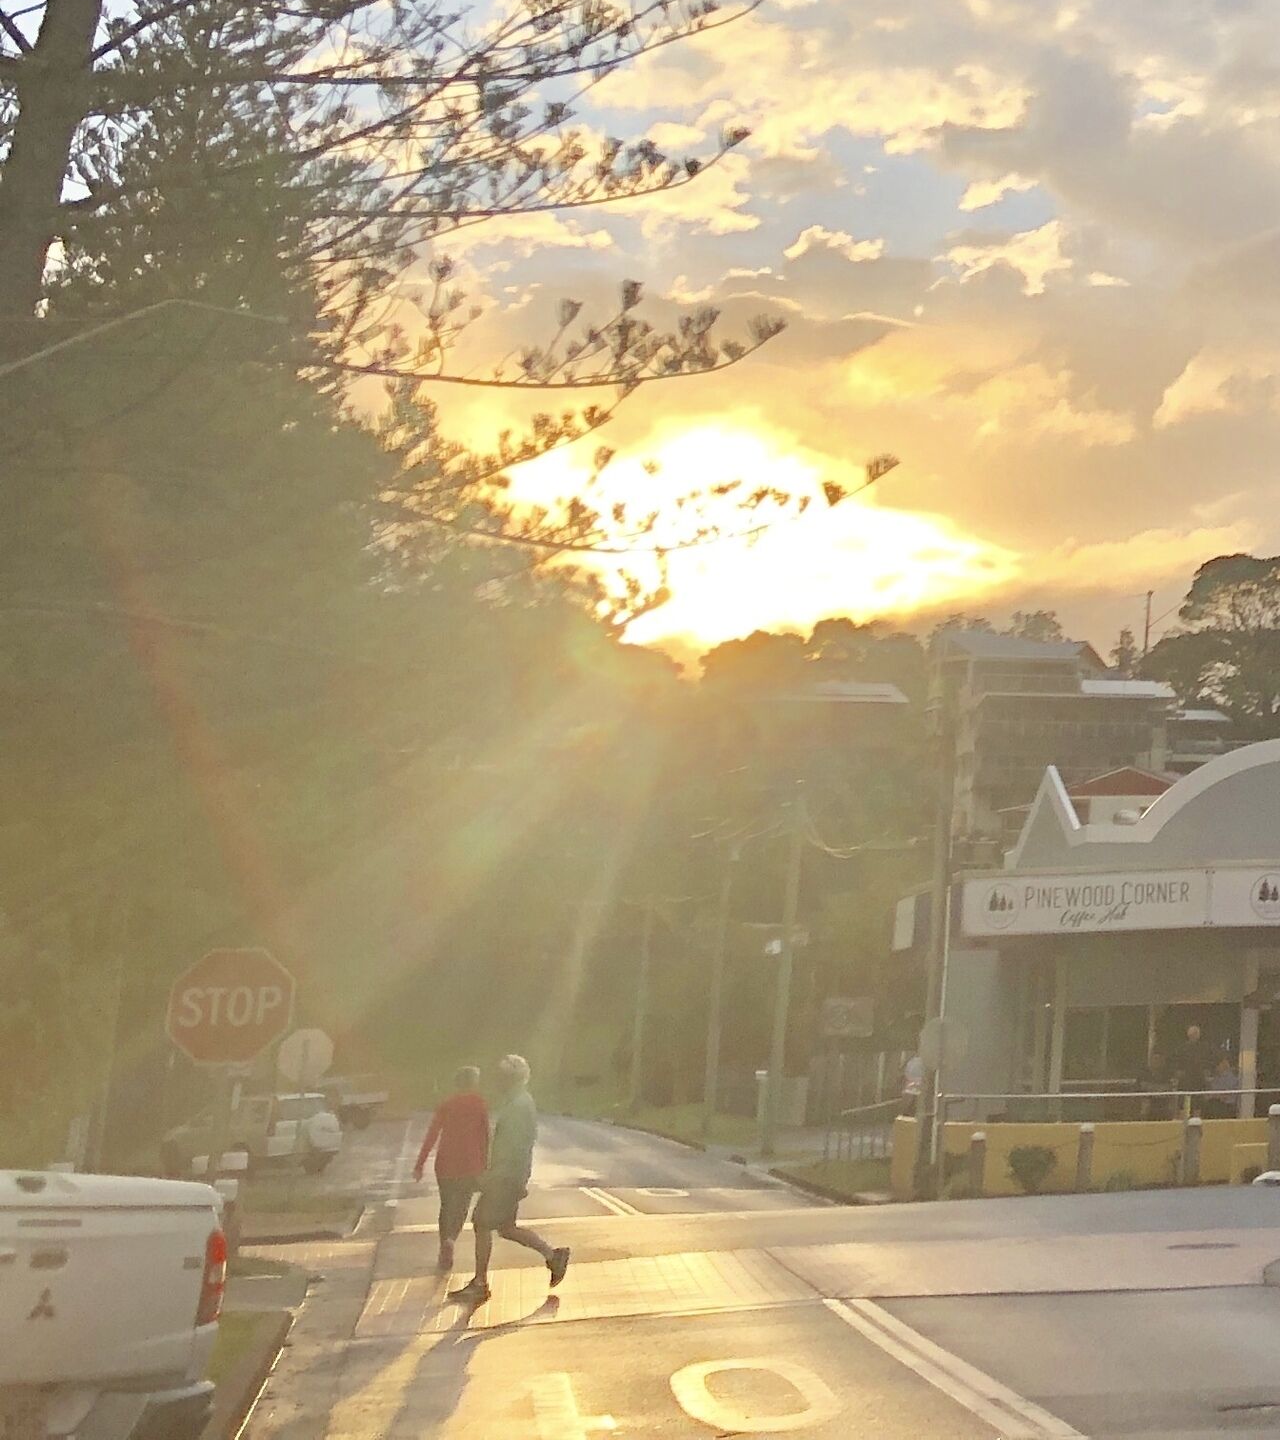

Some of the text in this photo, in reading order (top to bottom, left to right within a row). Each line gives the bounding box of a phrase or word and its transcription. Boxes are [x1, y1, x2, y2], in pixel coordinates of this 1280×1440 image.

[1024, 881, 1190, 910] PINEWOOD CORNER
[1060, 905, 1127, 927] Coffee Hub
[178, 985, 282, 1028] STOP
